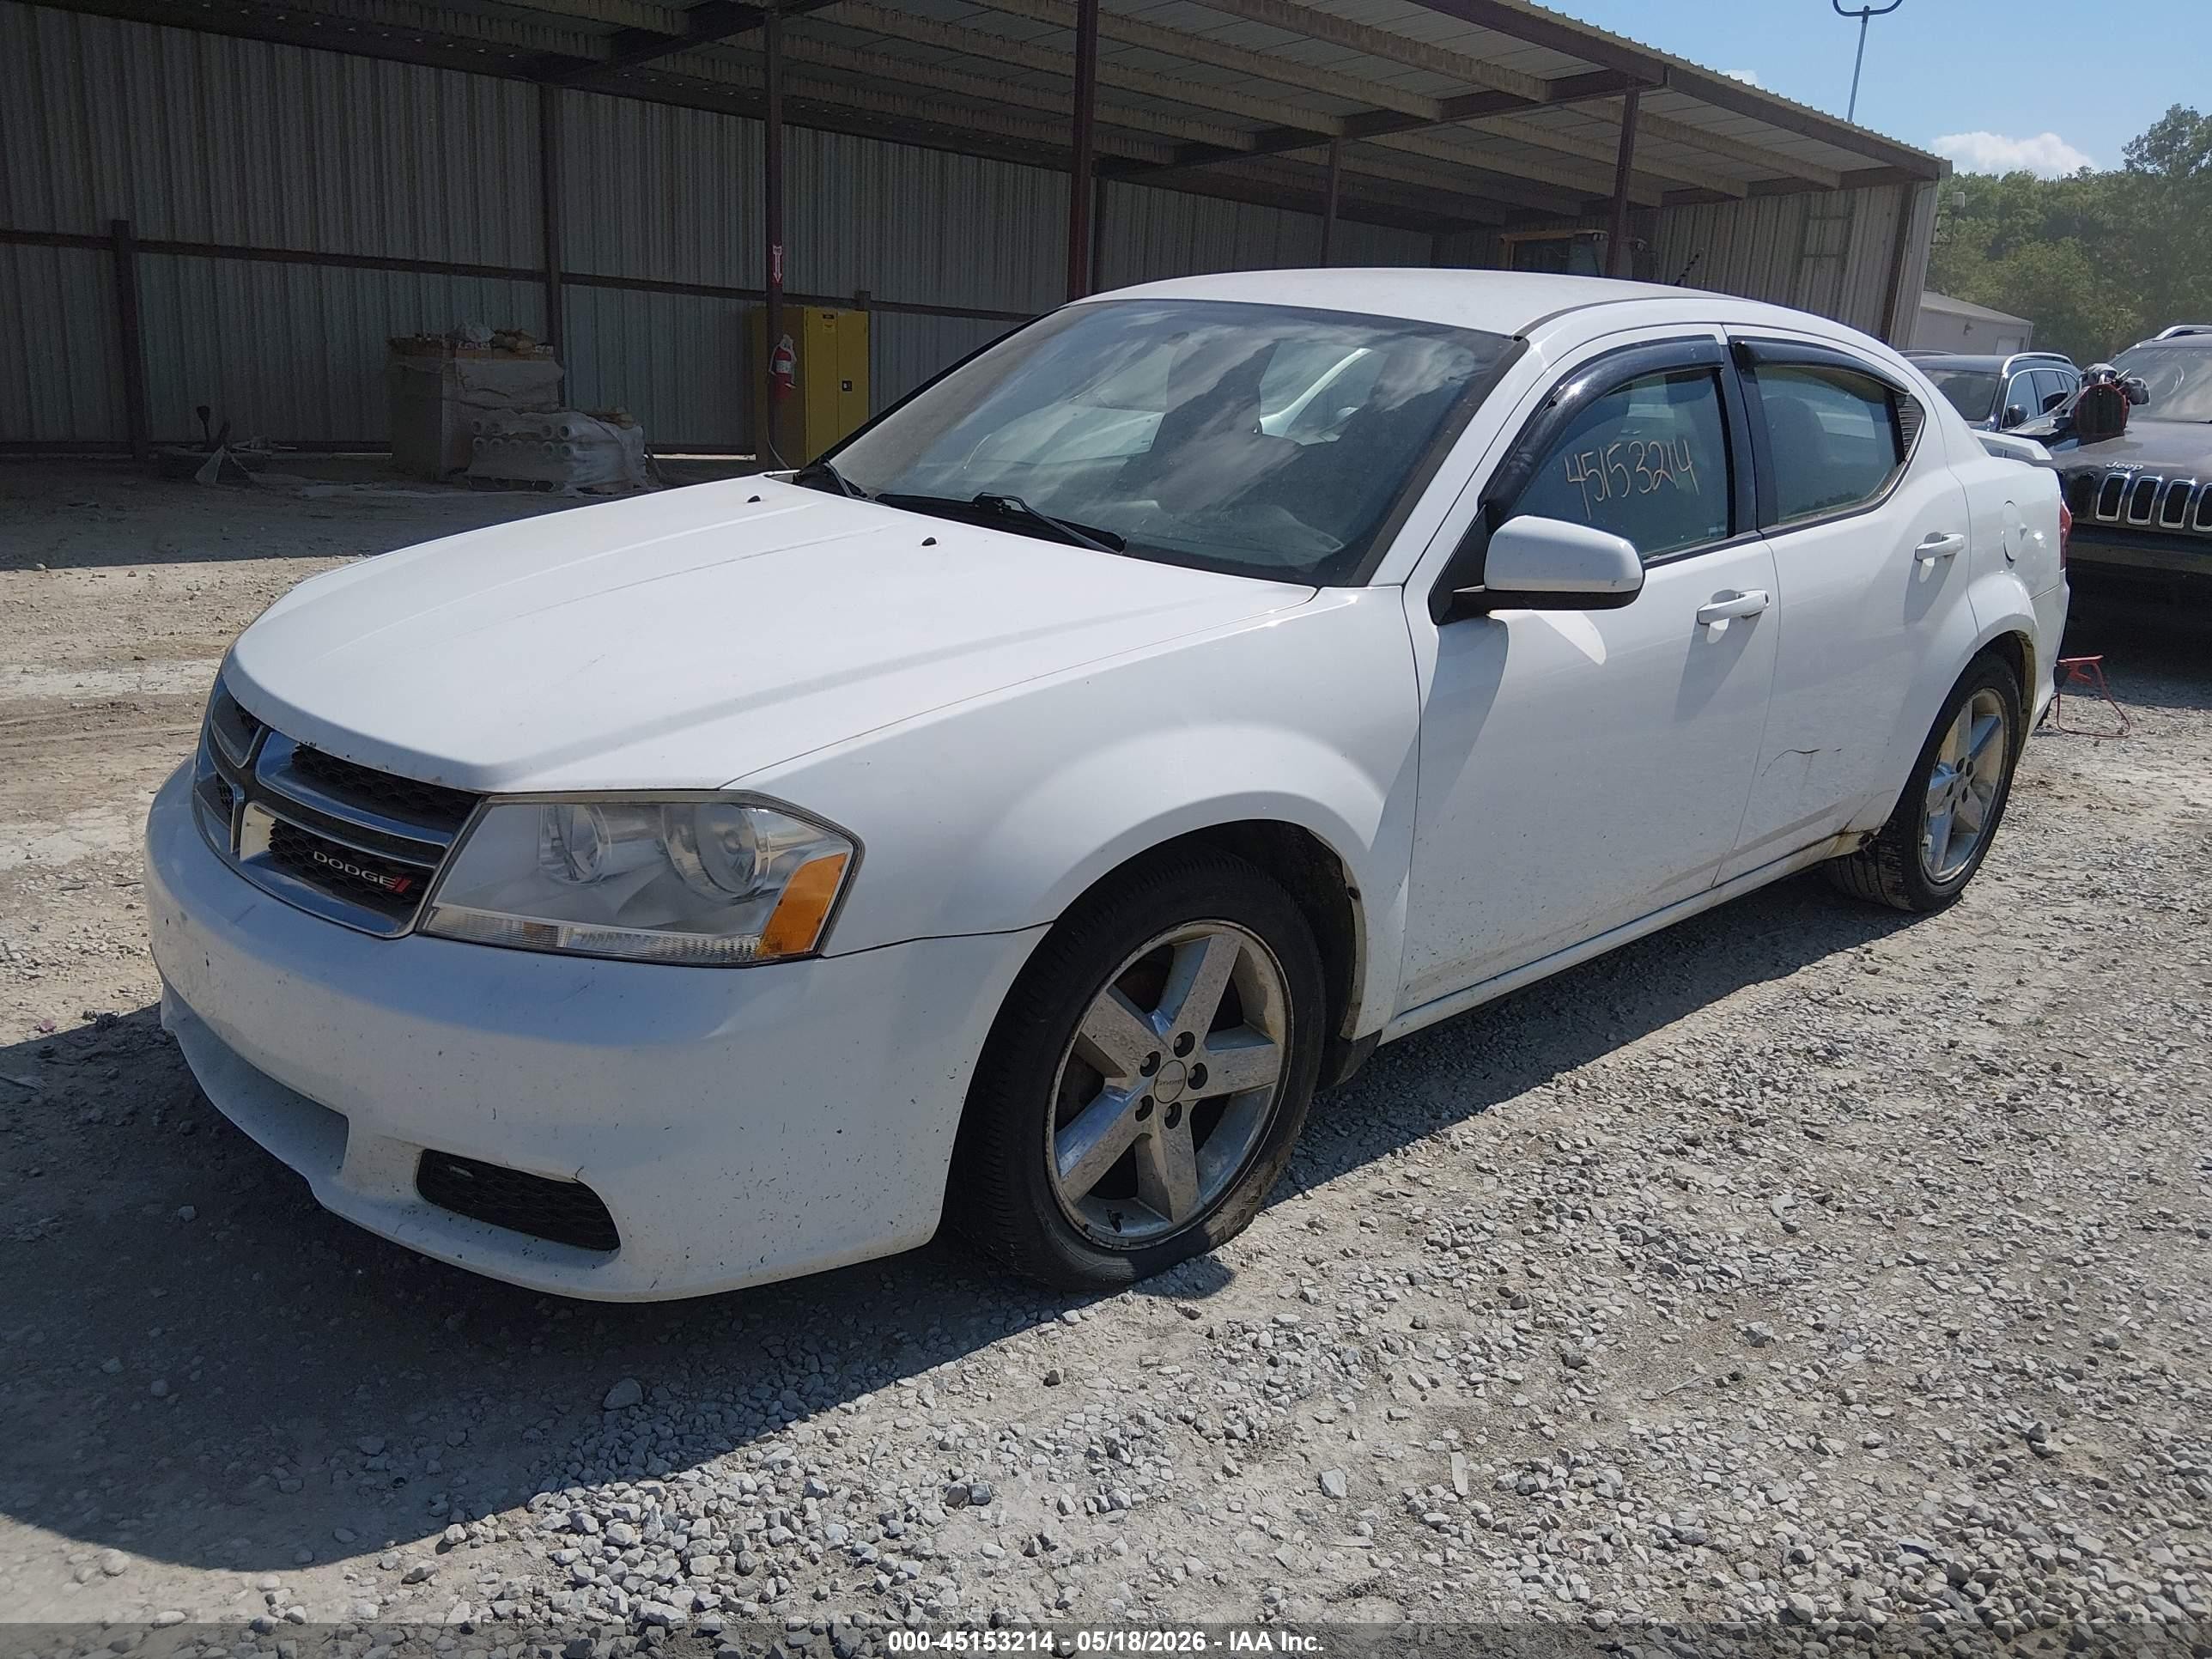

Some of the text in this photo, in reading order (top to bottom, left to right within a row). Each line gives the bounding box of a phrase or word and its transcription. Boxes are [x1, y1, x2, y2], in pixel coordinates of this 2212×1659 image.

[1565, 439, 1701, 521] 45153214
[2106, 461, 2144, 471] Jeep
[313, 851, 396, 889] DODGE
